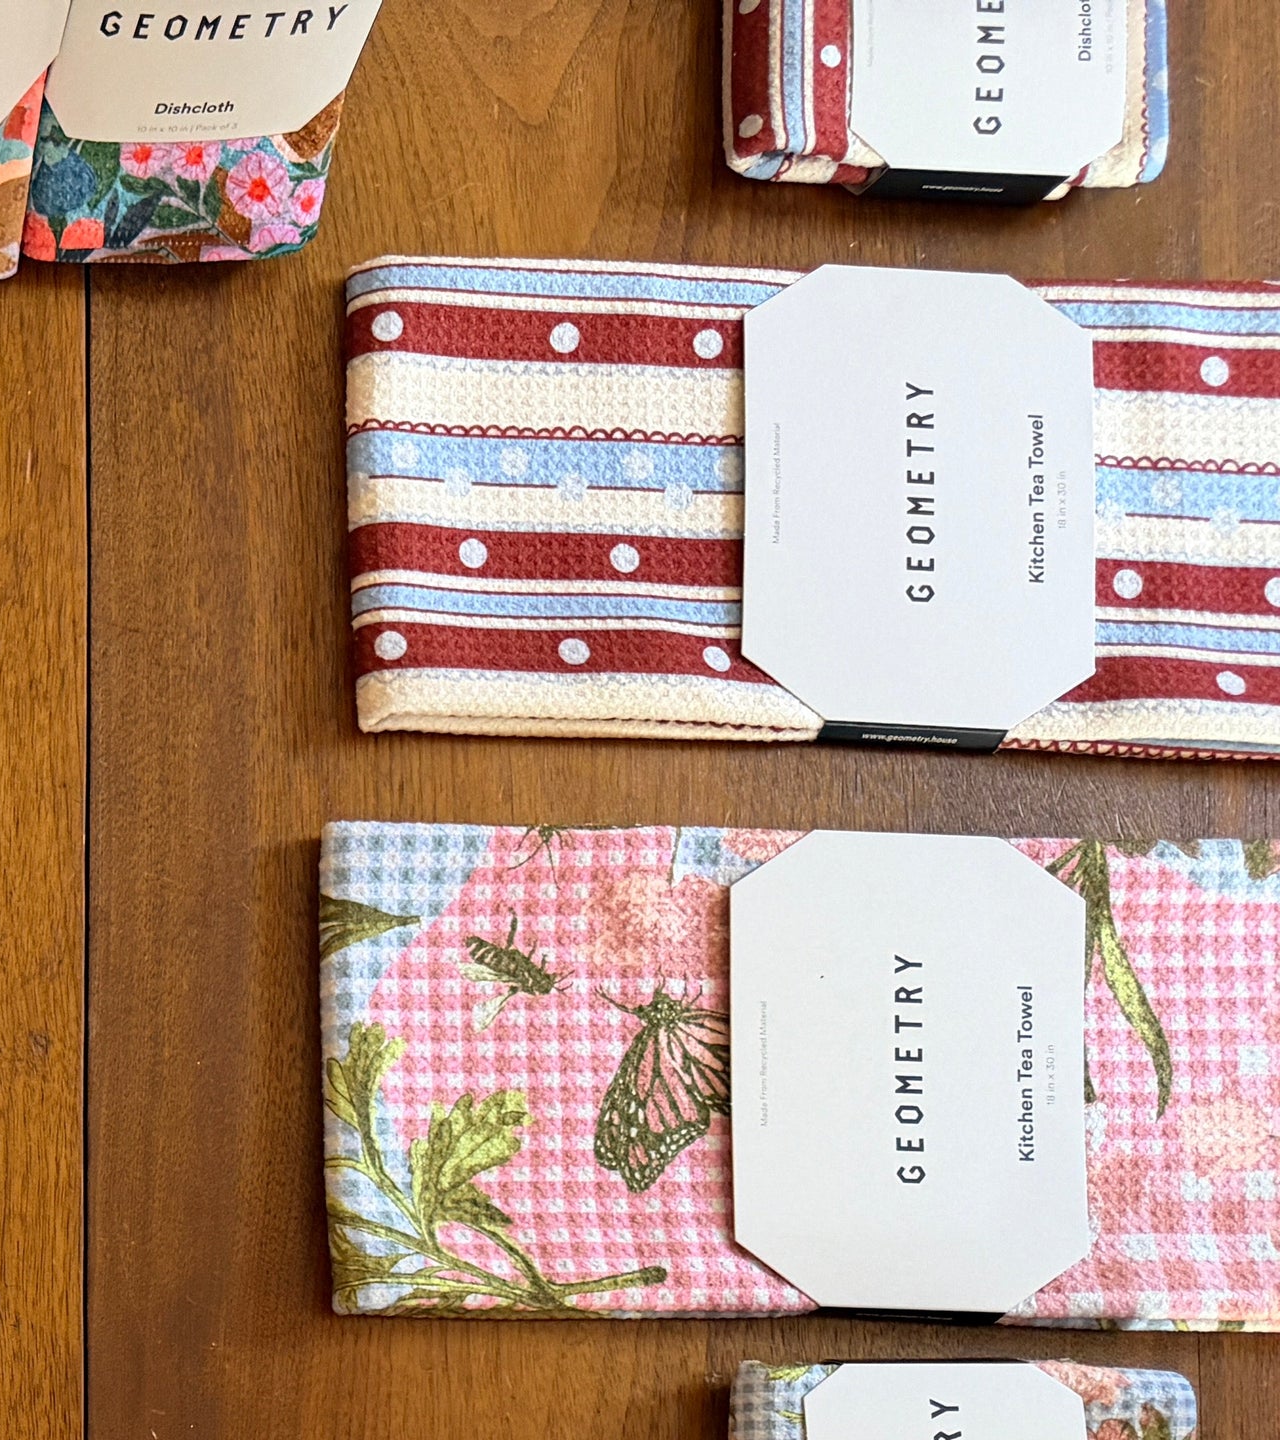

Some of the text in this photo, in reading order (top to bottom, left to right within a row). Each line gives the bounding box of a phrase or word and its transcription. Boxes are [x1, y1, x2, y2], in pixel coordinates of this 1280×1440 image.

[99, 3, 348, 41] GEOMETRY
[154, 100, 234, 114] Dishcloth
[905, 382, 935, 602] GEOMETRY
[1027, 414, 1044, 583] Kitchen Tea Towel
[862, 733, 958, 744] www.geometry.house
[894, 954, 926, 1184] GEOMETRY
[1016, 986, 1034, 1161] Kitchen Tea Towel
